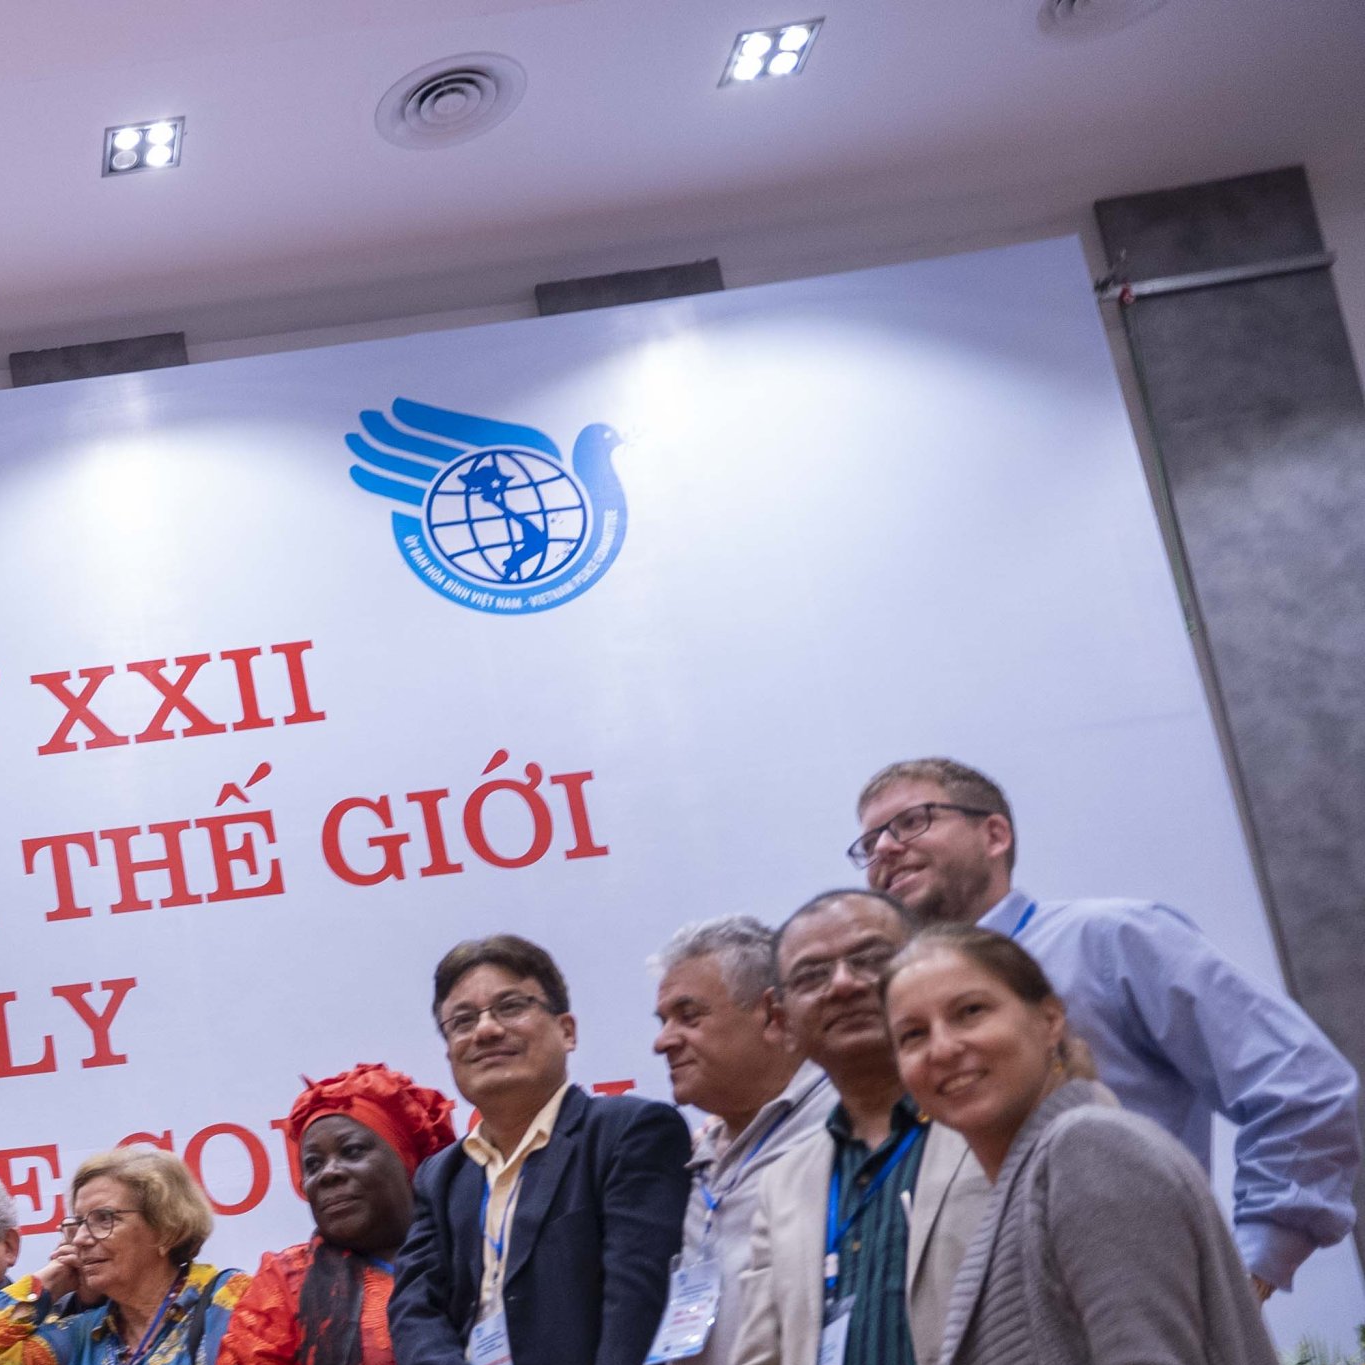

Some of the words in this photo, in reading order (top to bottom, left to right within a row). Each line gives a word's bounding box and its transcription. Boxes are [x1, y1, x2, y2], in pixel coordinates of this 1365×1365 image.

[410, 547, 429, 569] BAN
[470, 591, 495, 608] VIỆT
[495, 597, 522, 609] NAM
[32, 640, 324, 756] XXII
[22, 762, 284, 921] THẾ
[322, 751, 606, 885] GIỚI
